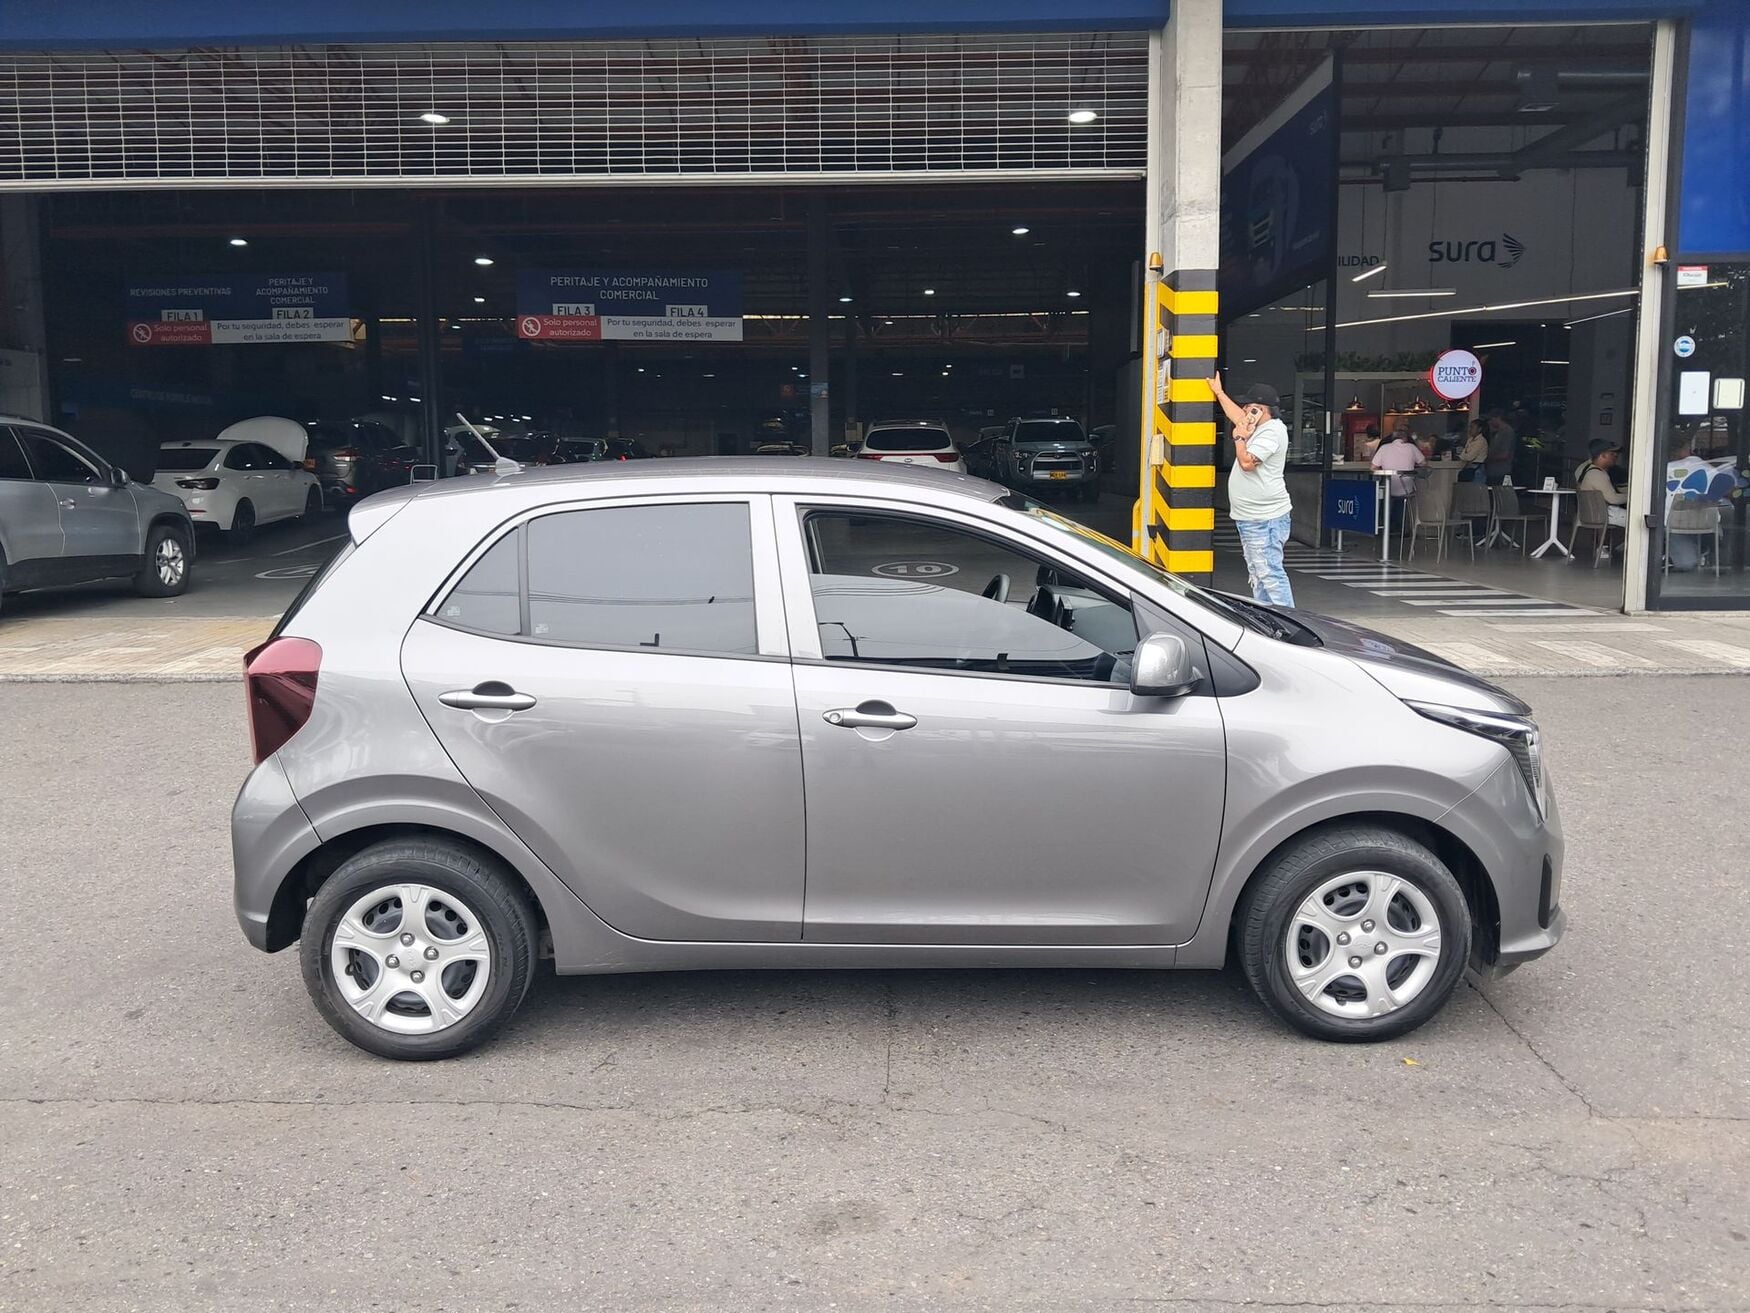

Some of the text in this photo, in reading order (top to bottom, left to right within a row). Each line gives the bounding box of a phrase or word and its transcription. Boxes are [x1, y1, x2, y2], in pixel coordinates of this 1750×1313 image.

[1429, 240, 1496, 262] sura
[268, 278, 313, 286] PERITAJE Y
[550, 275, 708, 288] PERITAJE Y ACOMPAÑAMIENTO
[130, 287, 232, 297] REVISIONES PREVENTIVAS
[600, 290, 659, 300] COMERCIAL
[270, 297, 315, 305] COMERCIAL
[277, 309, 310, 319] FILA 2
[557, 306, 590, 316] FILA 3
[670, 307, 704, 317] FILA 4
[167, 312, 199, 321] FILA 1
[217, 322, 230, 330] Por
[231, 322, 240, 330] tu
[286, 321, 310, 329] debes
[314, 322, 344, 330] esperar
[562, 318, 597, 328] personal
[607, 318, 736, 329] Por tu seguridad, debes esperar
[172, 323, 207, 334] personal
[550, 329, 592, 337] autorizado
[160, 333, 202, 342] autorizado
[256, 333, 263, 341] la
[265, 333, 280, 341] sala
[282, 332, 292, 341] de
[294, 333, 321, 342] espera
[645, 330, 653, 338] la
[654, 330, 671, 338] sala
[672, 330, 683, 338] de
[684, 332, 713, 340] espera
[1437, 366, 1477, 376] PUNTO
[1437, 375, 1477, 383] CALIENTE
[1337, 499, 1354, 515] sura
[889, 564, 942, 574] 10
